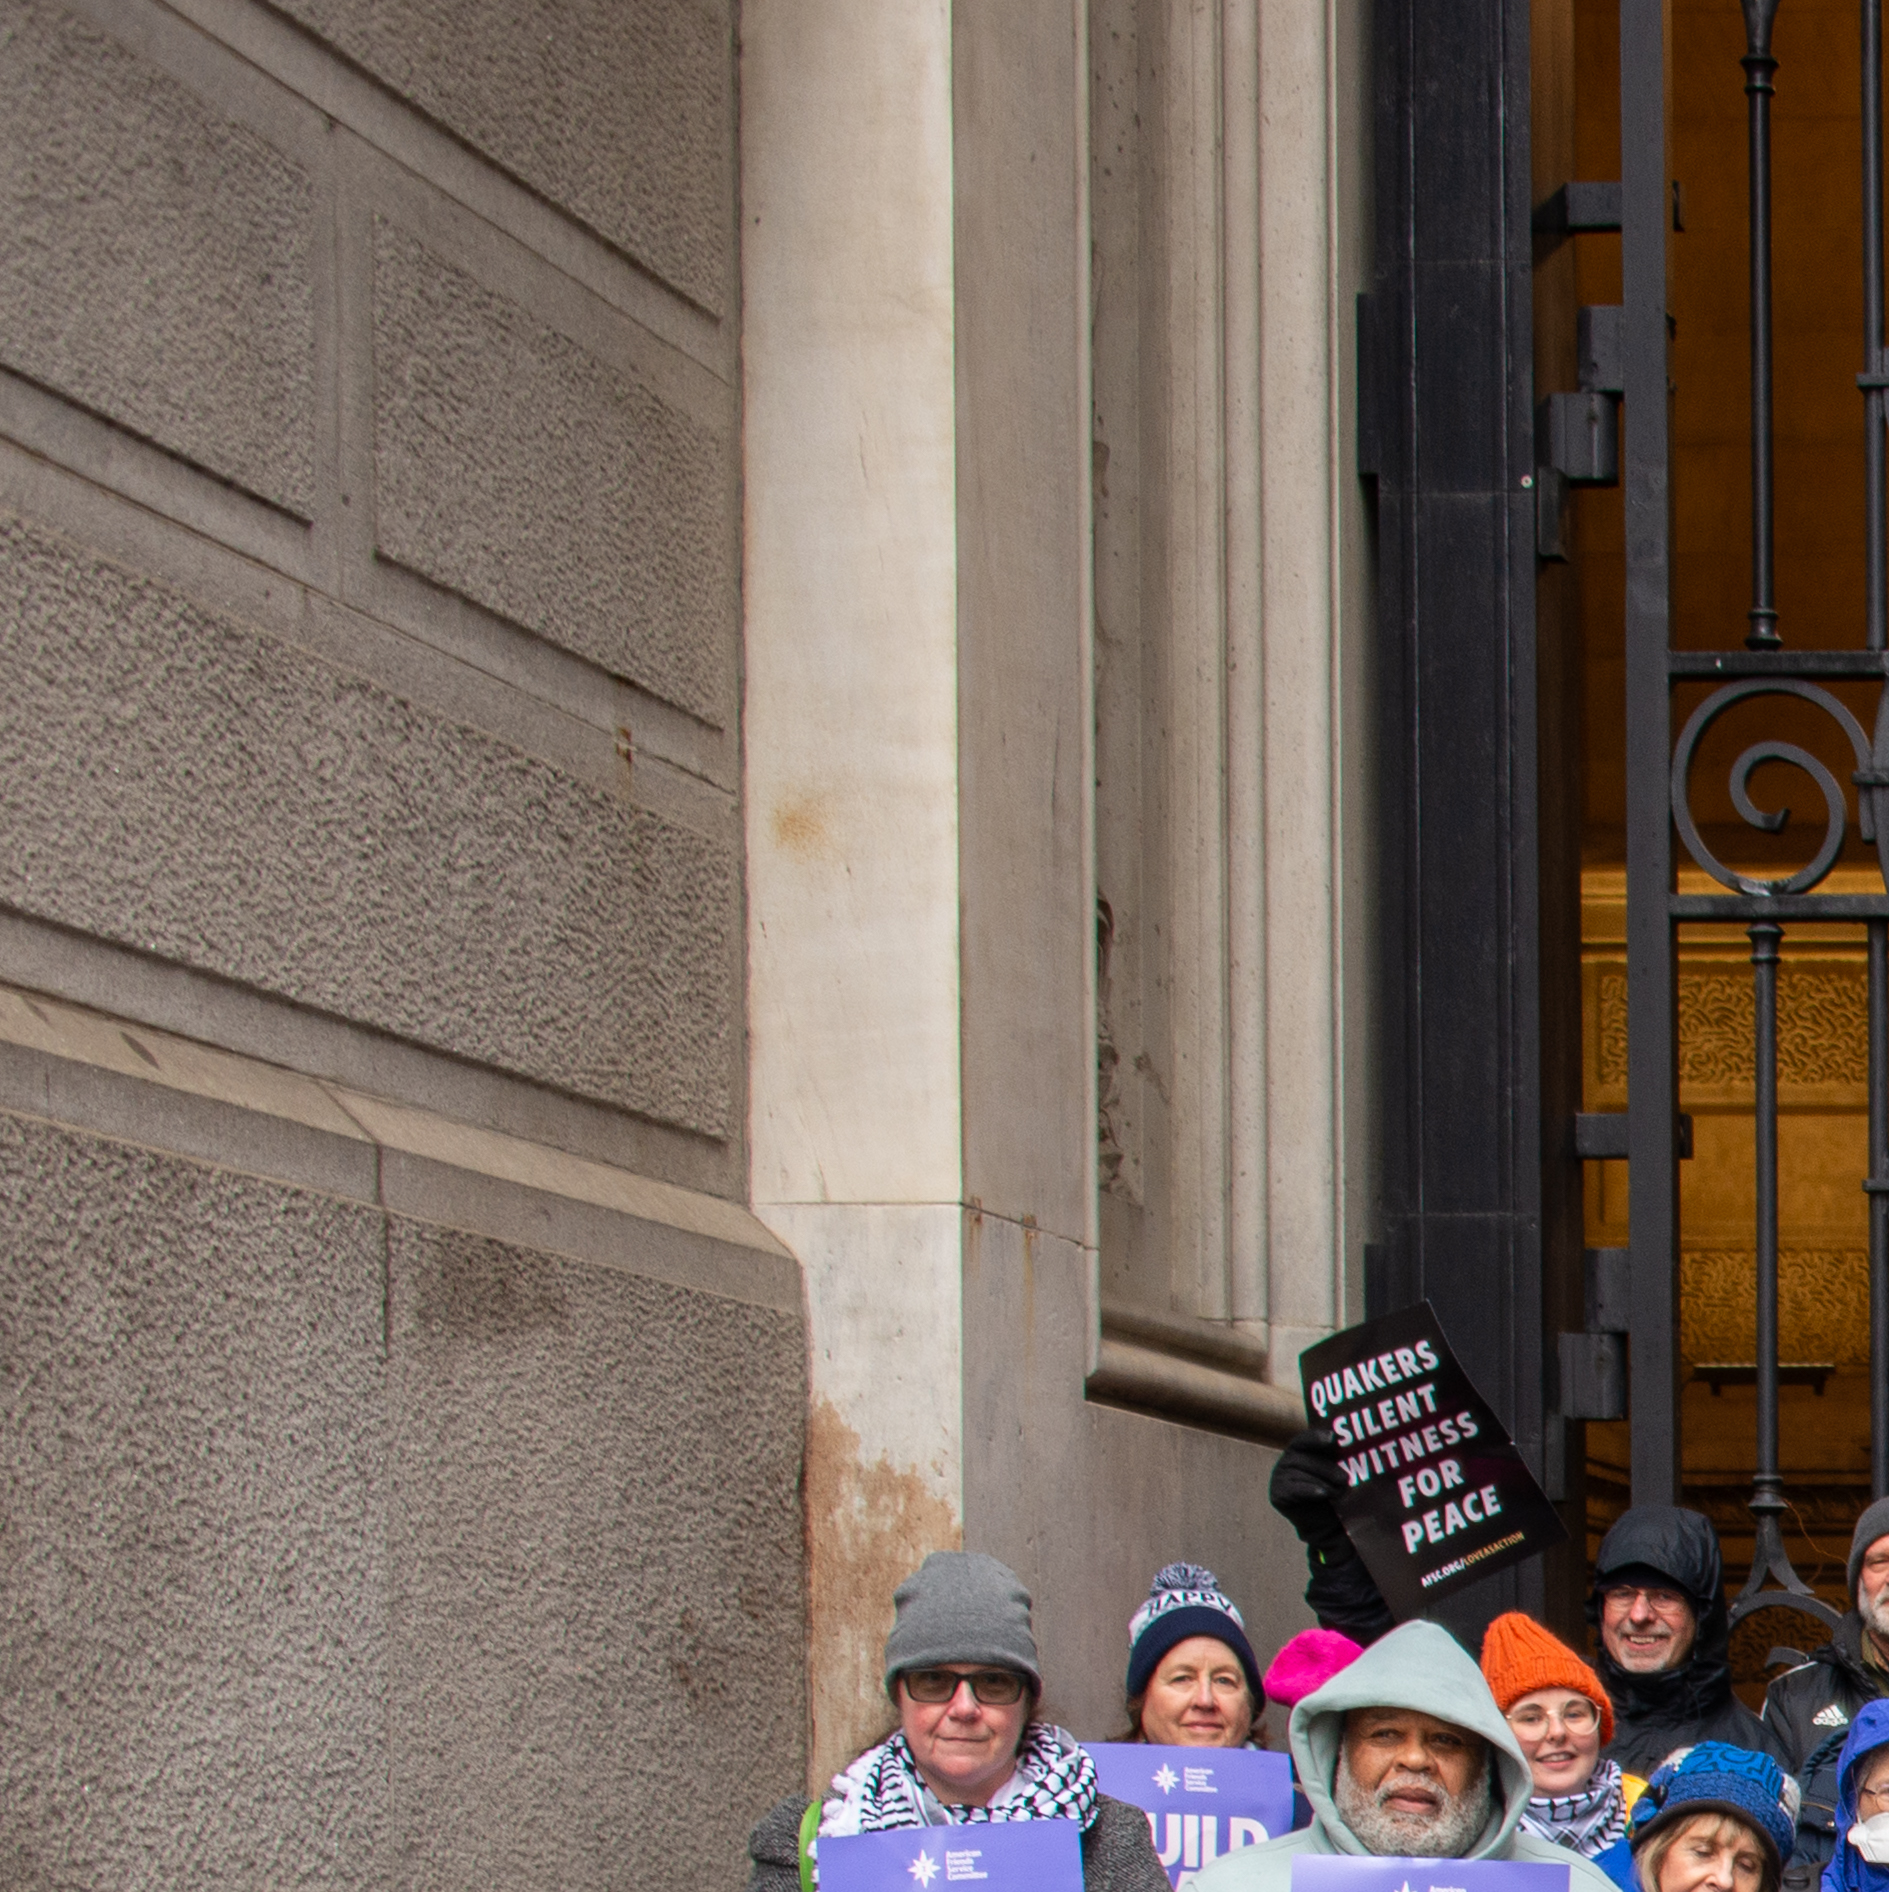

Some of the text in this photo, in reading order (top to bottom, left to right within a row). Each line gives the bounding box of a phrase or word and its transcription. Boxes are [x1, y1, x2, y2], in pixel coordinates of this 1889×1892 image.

[1311, 1340, 1439, 1417] QUAKERS
[1333, 1384, 1437, 1447] SILENT
[1338, 1411, 1479, 1487] WITNESS
[1398, 1459, 1464, 1508] FOR
[1402, 1484, 1502, 1554] PEACE
[1421, 1531, 1525, 1588] AFSC.ORG/LOVEASACTION
[1146, 1812, 1270, 1868] UILD
